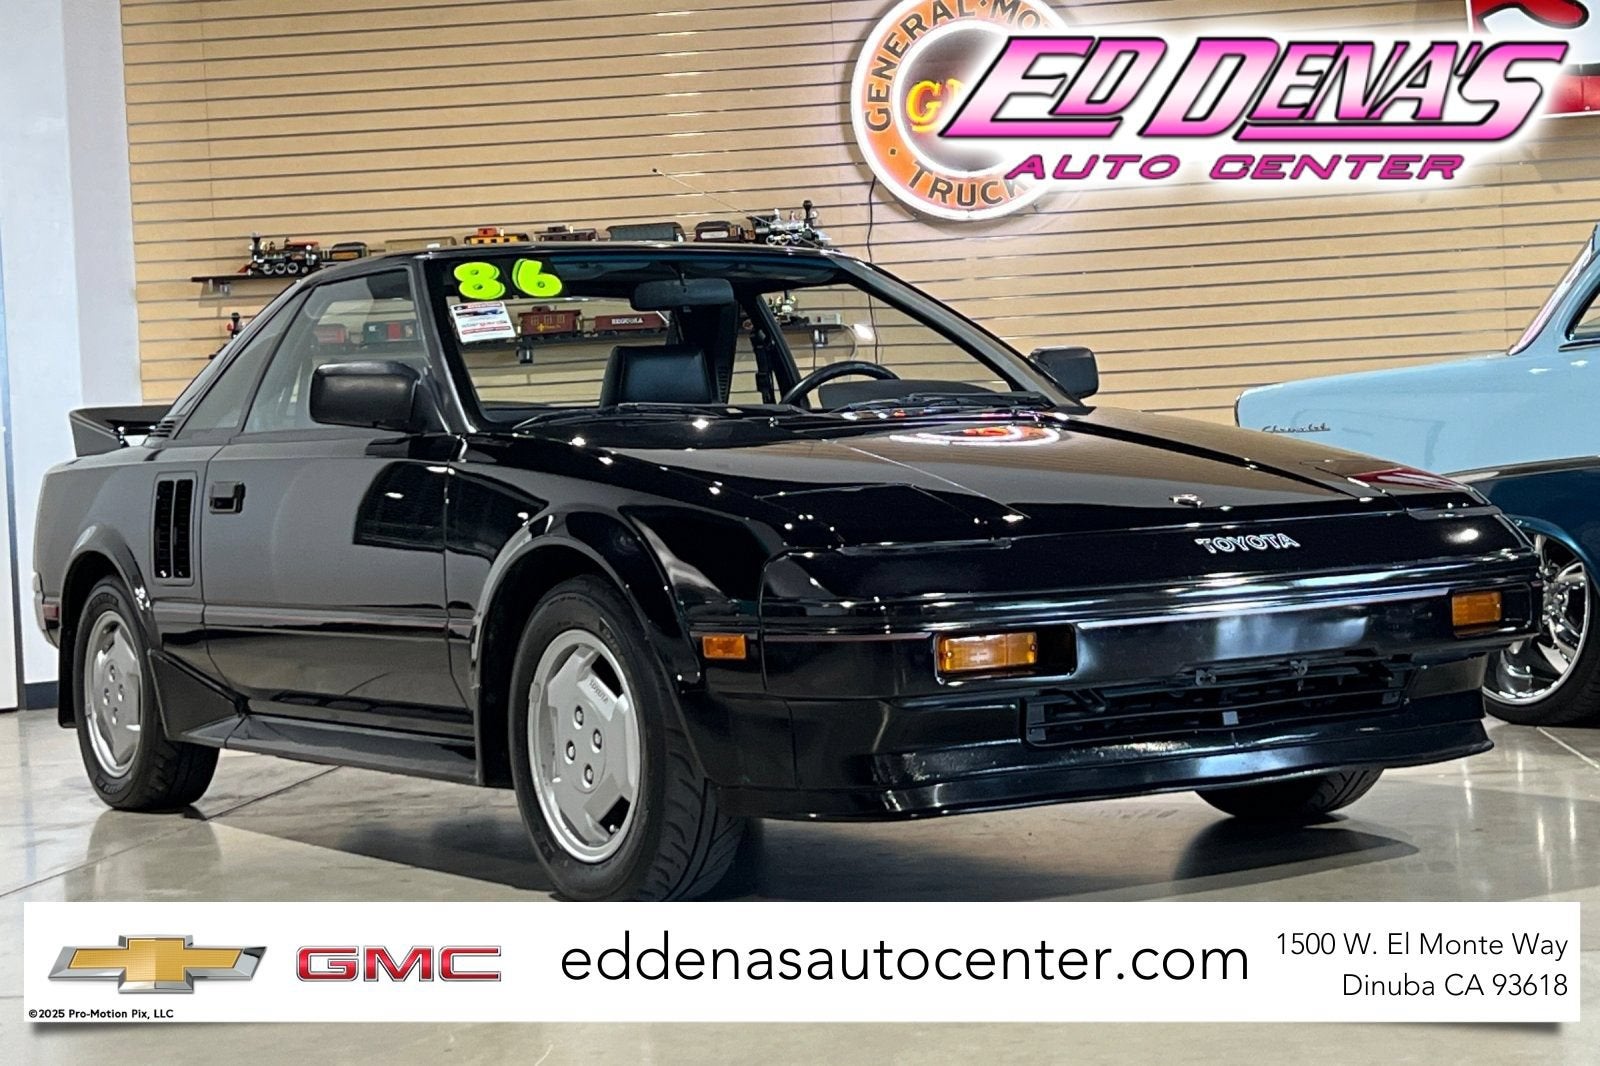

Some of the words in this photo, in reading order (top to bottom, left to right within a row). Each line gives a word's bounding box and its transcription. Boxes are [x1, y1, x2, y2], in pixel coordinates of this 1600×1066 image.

[865, 0, 975, 132] GENERAL
[454, 258, 563, 300] 86
[1194, 533, 1301, 554] TOYOTA
